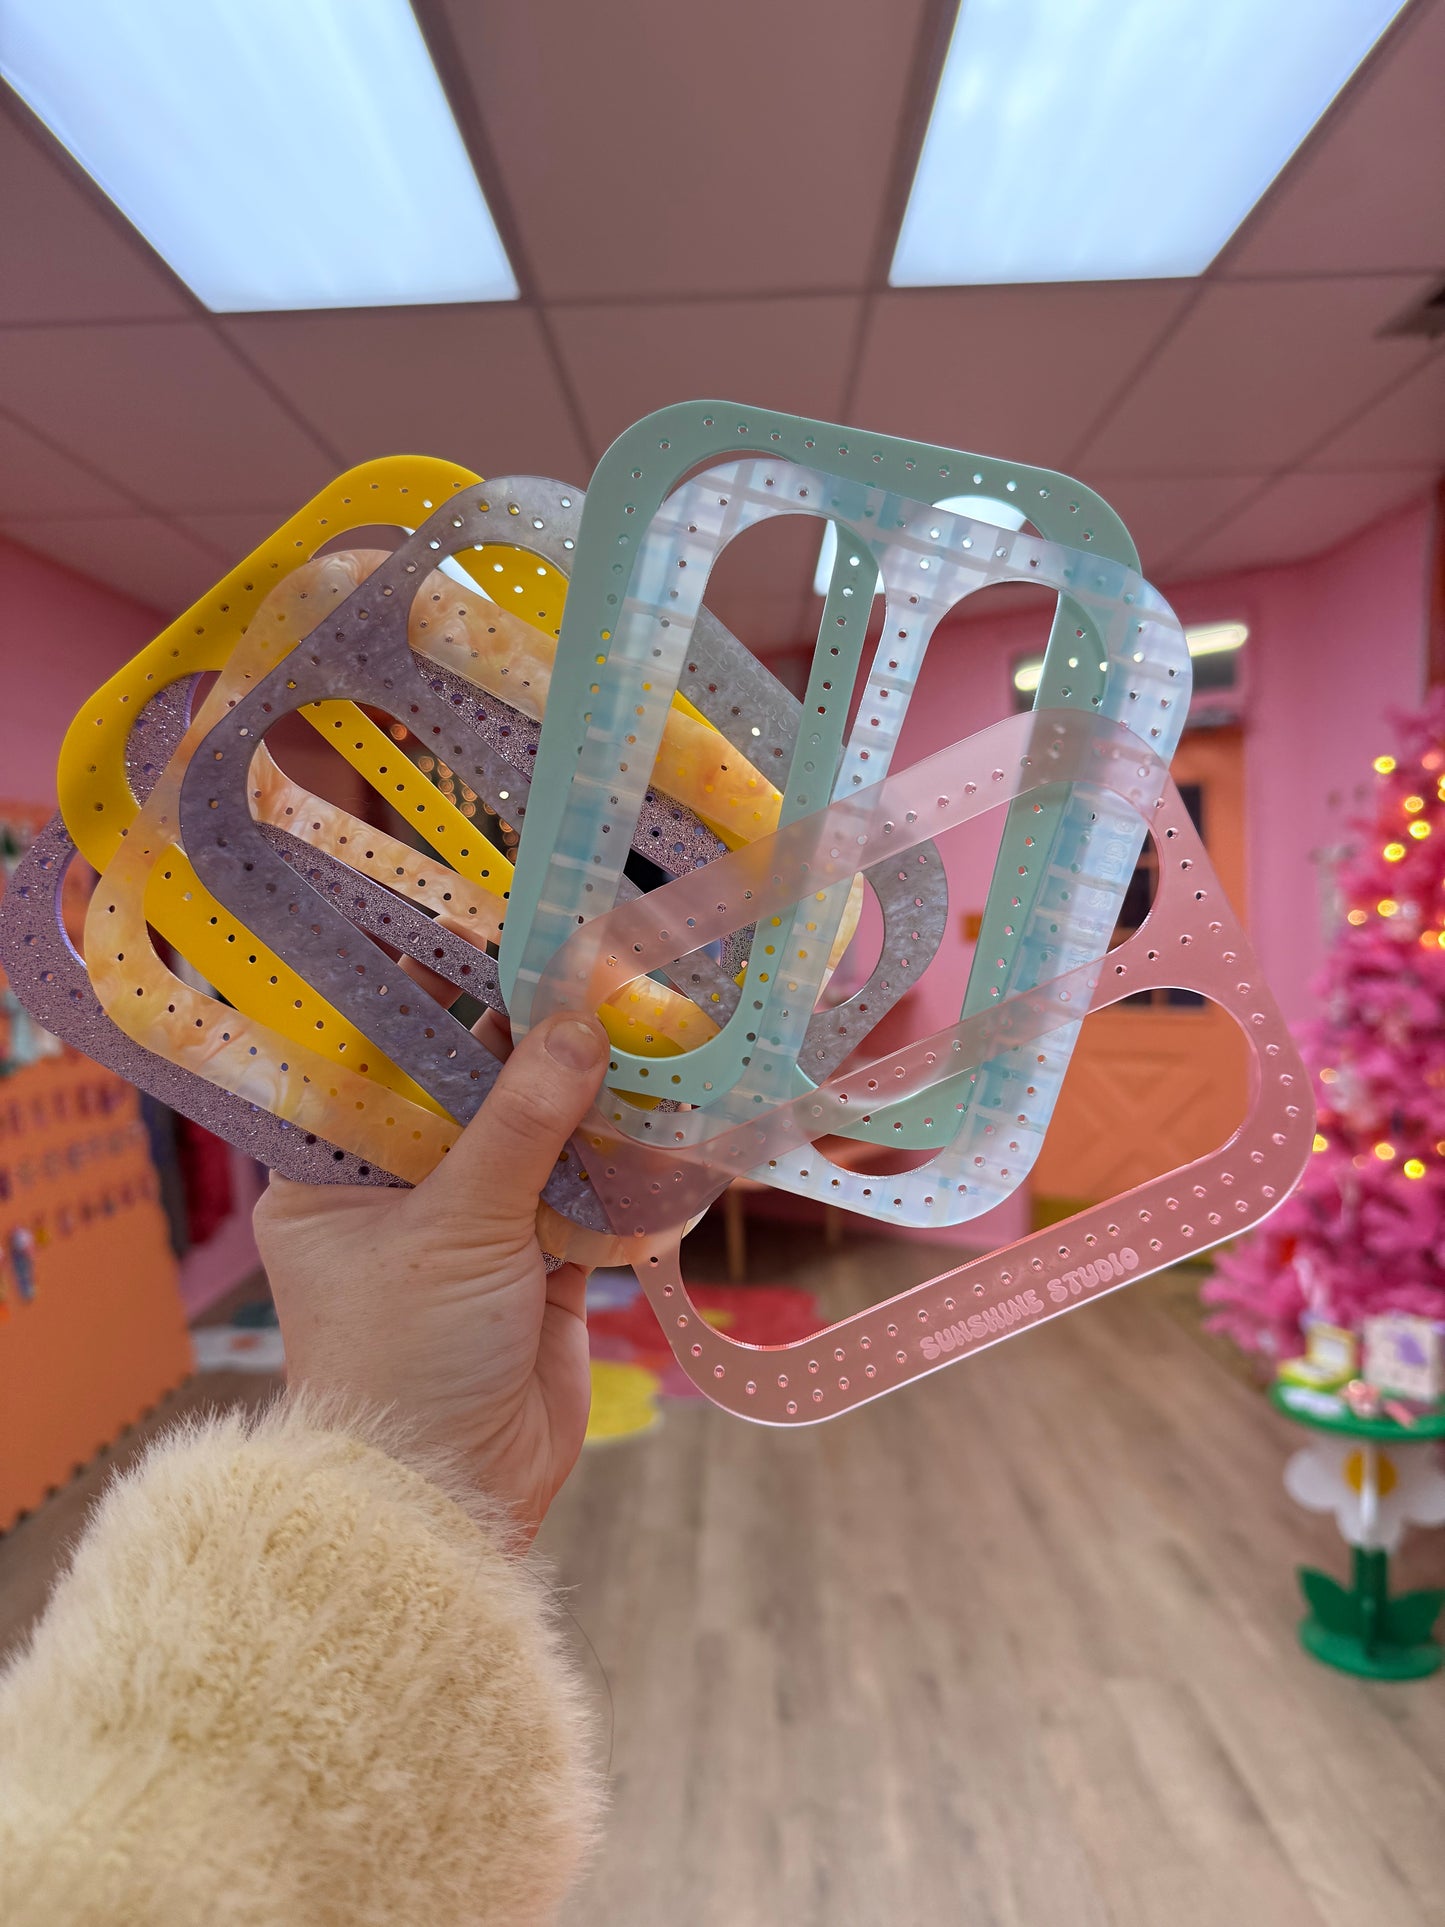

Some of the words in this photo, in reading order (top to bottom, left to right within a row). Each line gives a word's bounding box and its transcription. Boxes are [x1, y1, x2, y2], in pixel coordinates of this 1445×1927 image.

[1087, 816, 1138, 910] SUDIO
[920, 1289, 1044, 1361] SUNSHINE
[1047, 1247, 1139, 1302] STUDIO
